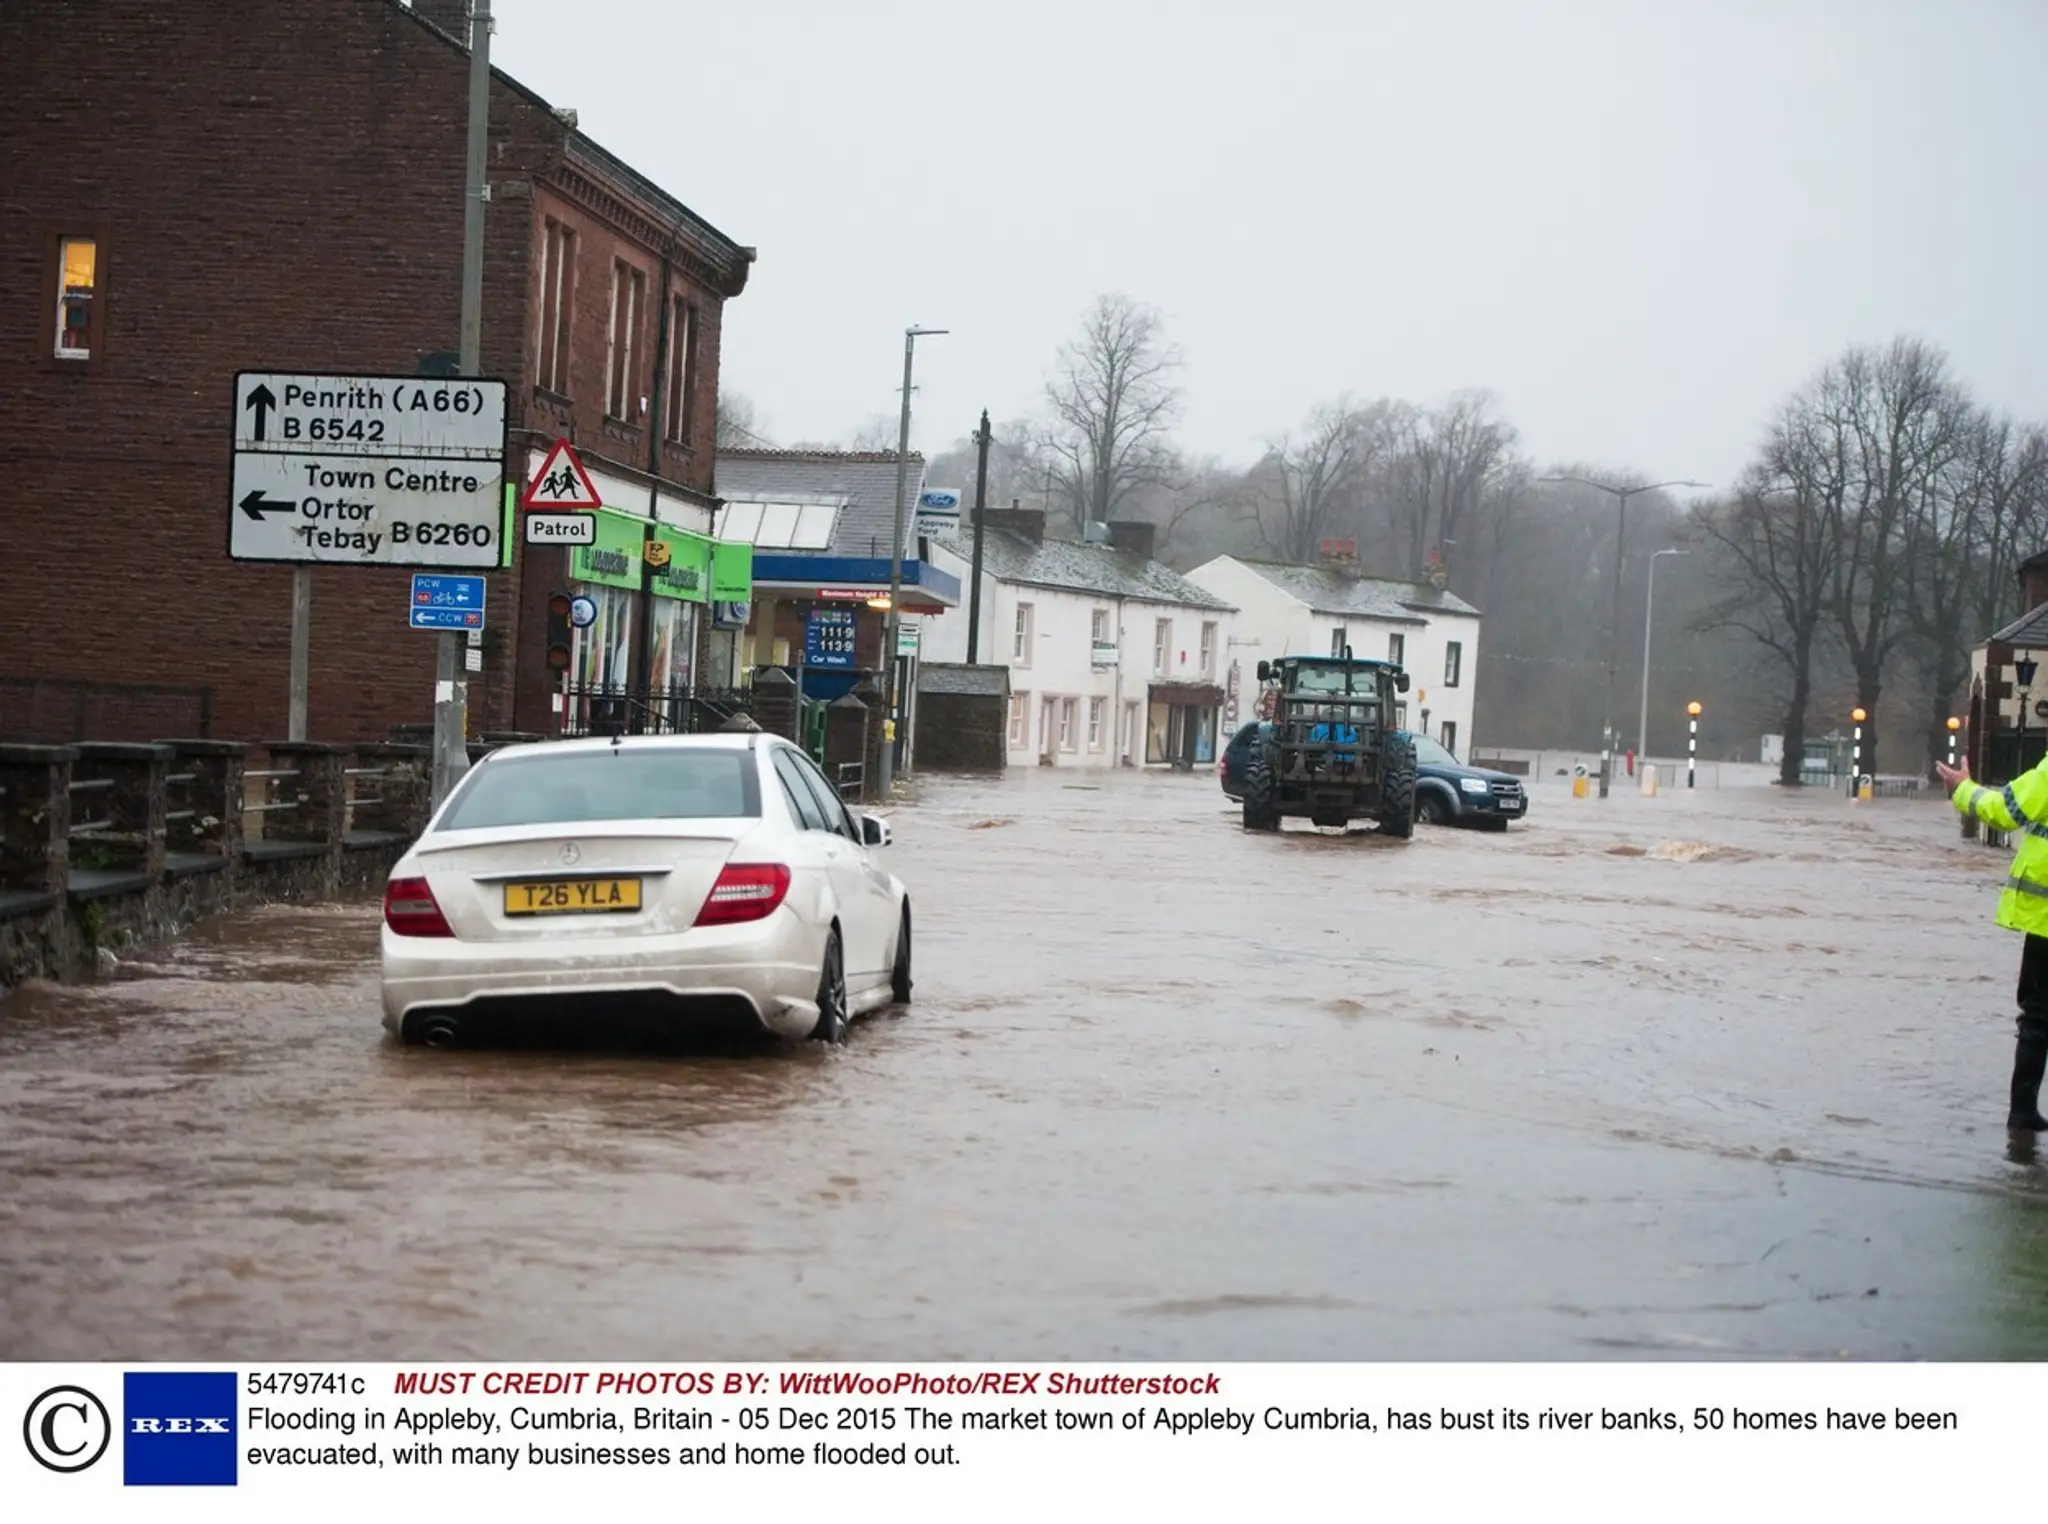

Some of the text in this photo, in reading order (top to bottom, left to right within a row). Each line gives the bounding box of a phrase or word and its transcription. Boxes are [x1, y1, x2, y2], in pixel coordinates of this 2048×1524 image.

[284, 385, 484, 415] Penrith (A66)
[304, 464, 478, 493] Town Centre
[534, 521, 586, 537] Patrol
[302, 526, 382, 554] Tebay
[417, 578, 440, 588] PCW
[438, 613, 463, 622] CCW
[811, 655, 847, 664] Car Wash
[523, 881, 622, 907] T26 YLA
